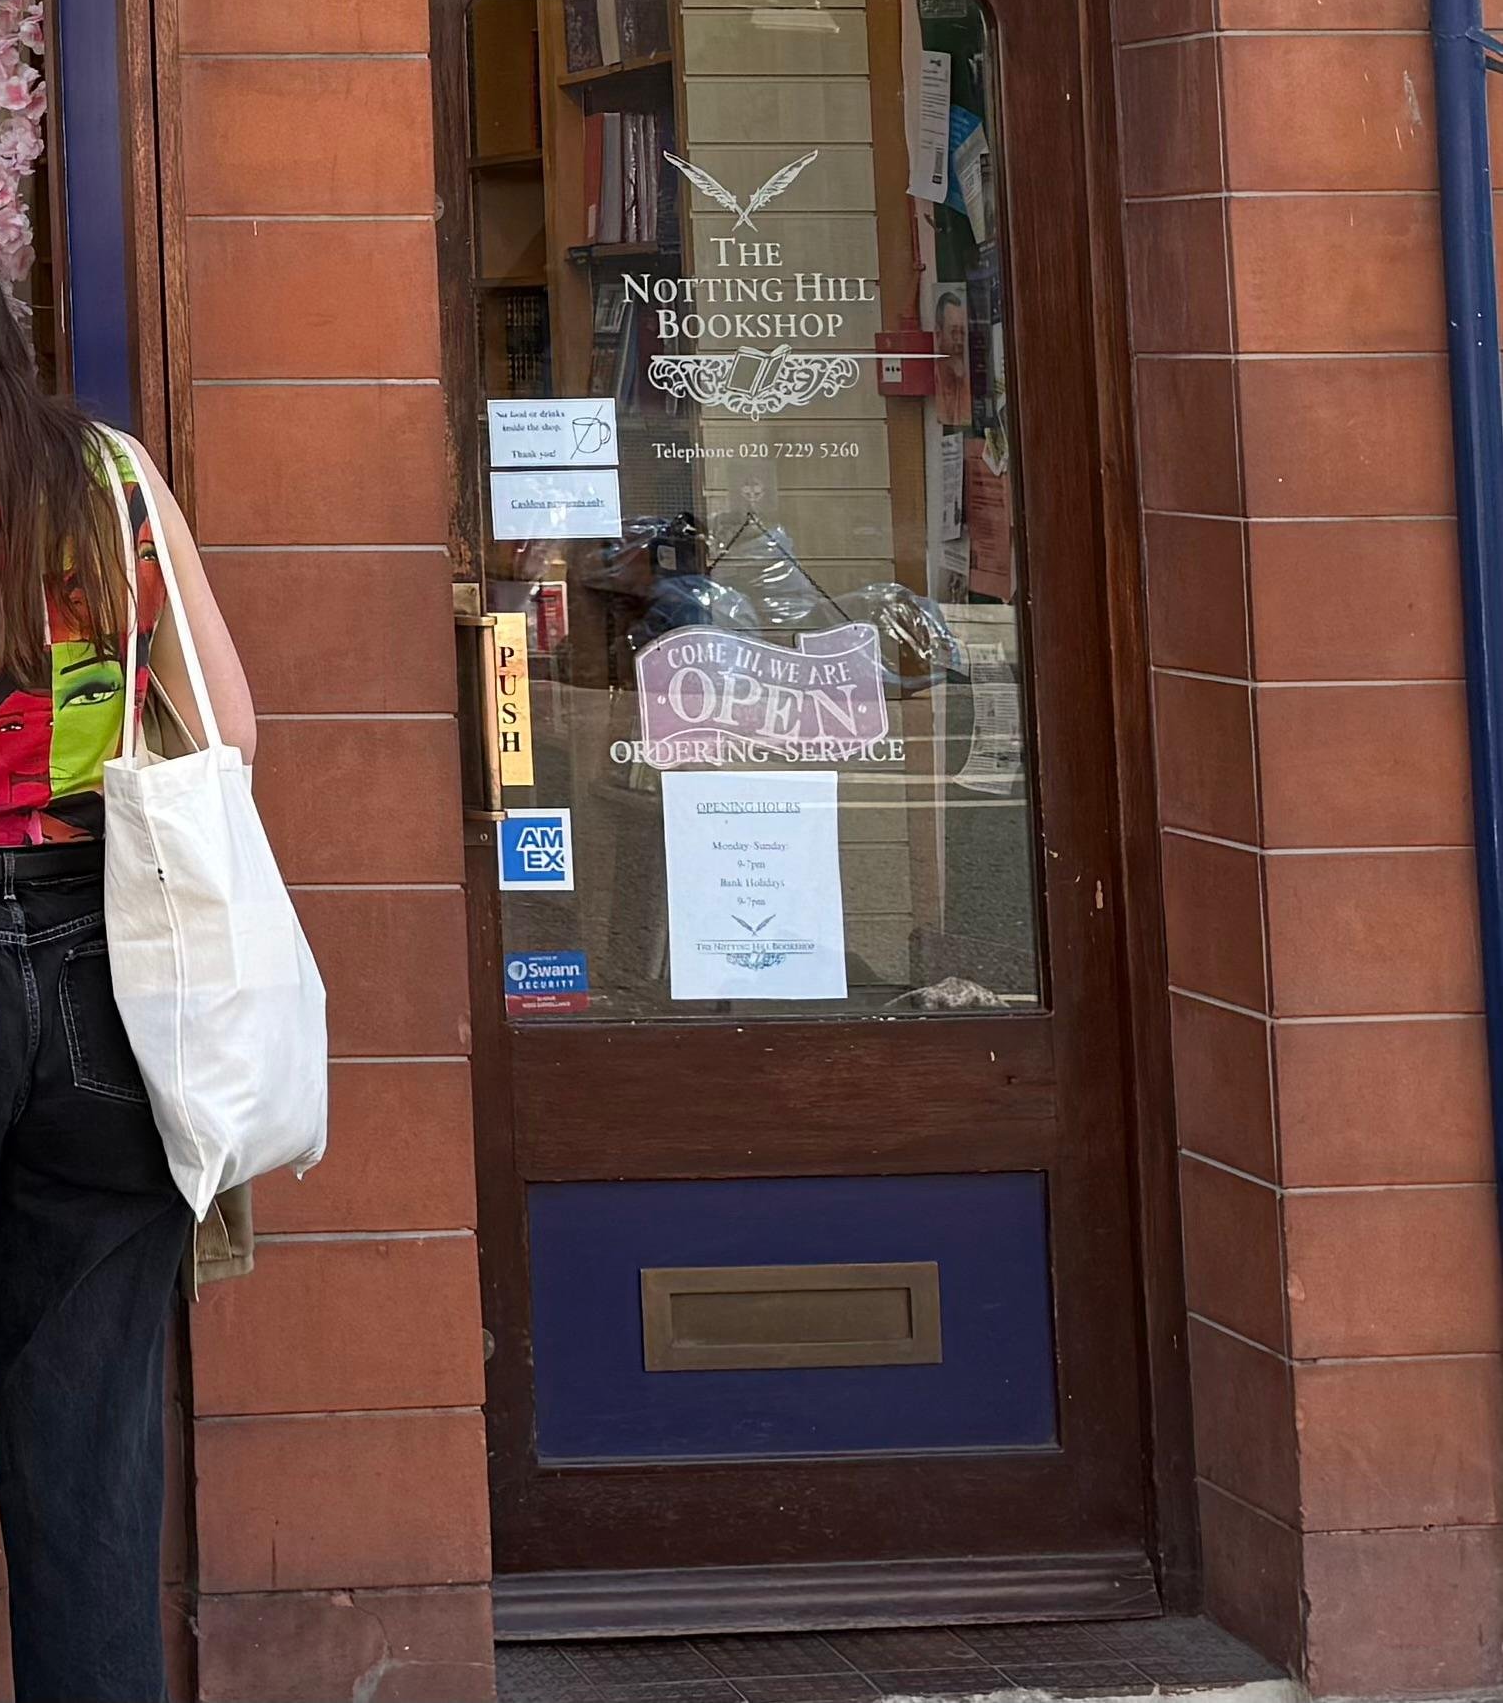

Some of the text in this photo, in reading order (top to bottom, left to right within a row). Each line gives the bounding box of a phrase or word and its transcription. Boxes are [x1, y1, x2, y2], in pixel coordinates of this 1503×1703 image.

[710, 238, 782, 267] THE
[621, 272, 875, 303] NOTTING HILL
[656, 310, 844, 339] BOOKSHOP
[652, 443, 859, 463] Telephone 020 7229 5260
[668, 643, 727, 669] COME
[770, 659, 798, 683] WE
[809, 662, 851, 685] ARE
[499, 647, 521, 752] PUSH
[668, 667, 857, 742] OPEN
[610, 739, 905, 764] ORDERING SERVICE
[697, 802, 800, 813] OPENING HOURS
[518, 980, 574, 989] SECURITY
[528, 963, 580, 977] Swann
